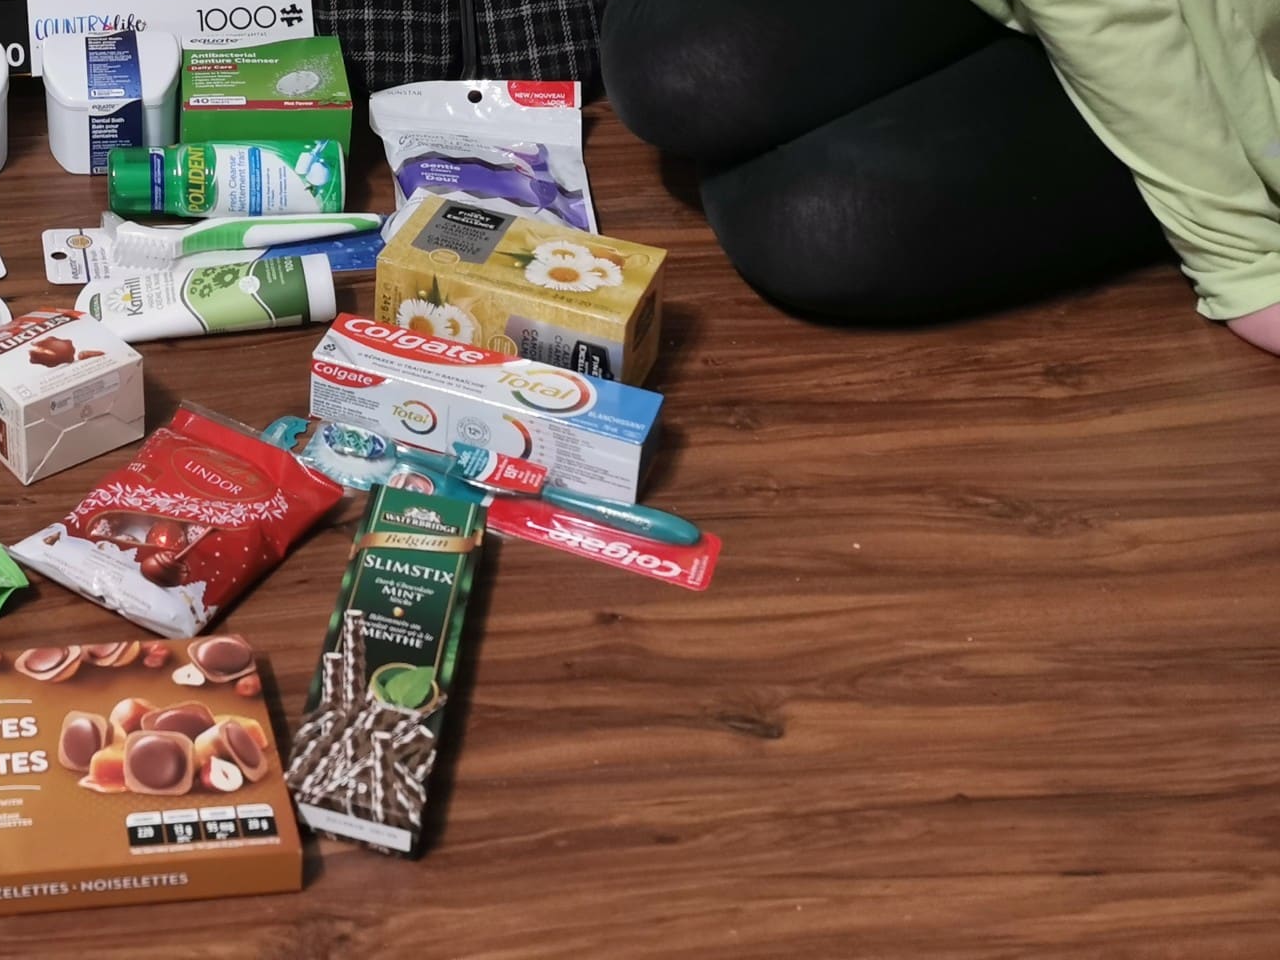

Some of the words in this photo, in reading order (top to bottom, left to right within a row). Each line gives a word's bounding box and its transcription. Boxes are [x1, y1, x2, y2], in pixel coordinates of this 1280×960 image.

[35, 15, 109, 40] COUNTRY
[196, 5, 277, 32] 1000
[228, 154, 236, 188] Cleanse
[420, 162, 461, 172] Gentle
[425, 175, 459, 184] Doux
[188, 146, 205, 214] POLIDENT
[238, 170, 246, 213] Nettement
[228, 191, 236, 213] Fresh
[125, 276, 144, 316] Kamill
[344, 318, 485, 364] Colgate
[314, 362, 373, 384] Colgate
[497, 368, 576, 401] Total
[392, 404, 430, 425] Total
[184, 460, 243, 494] LINDOR
[384, 512, 458, 534] WATERBRIDGE
[385, 534, 449, 548] Belgian
[548, 525, 682, 578] Colgate
[364, 554, 454, 585] SLIMSTIX
[382, 585, 425, 602] MINT
[396, 580, 435, 595] Chocolate
[360, 625, 424, 650] MENTHE
[80, 872, 188, 892] NOISELETTES
